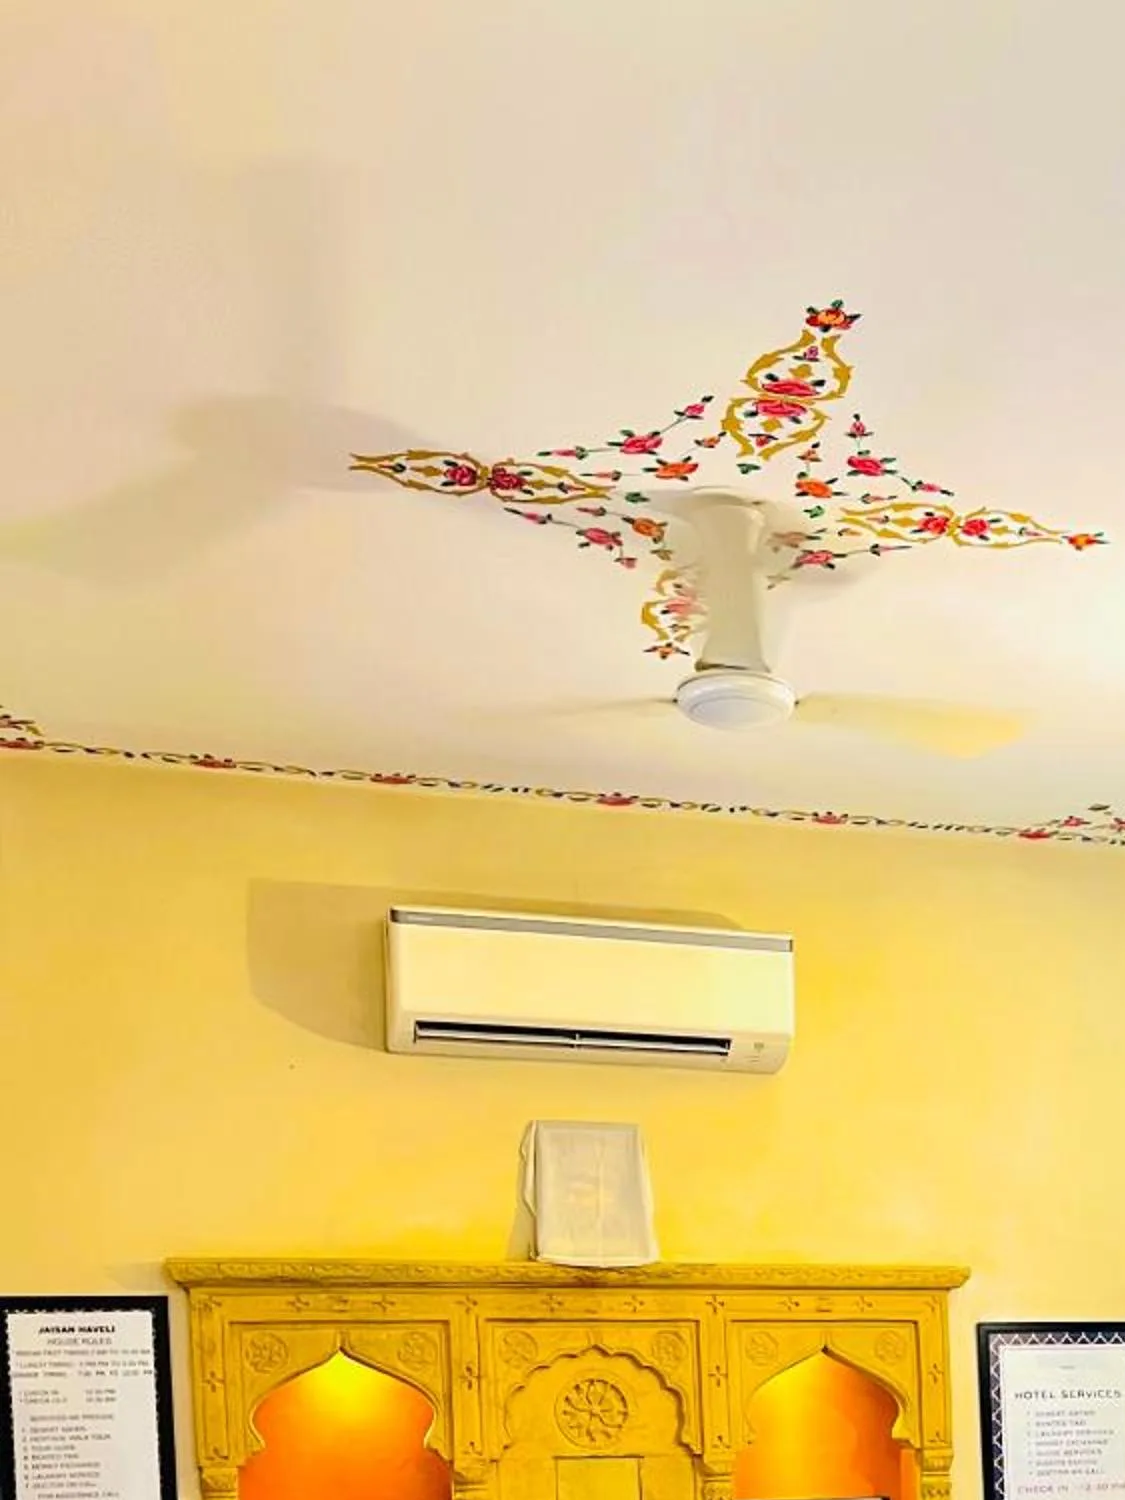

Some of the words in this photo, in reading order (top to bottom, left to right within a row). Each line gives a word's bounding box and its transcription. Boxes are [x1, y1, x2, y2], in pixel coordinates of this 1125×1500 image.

[78, 1325, 116, 1333] HAVELI
[1014, 1390, 1056, 1401] HOTEL
[1061, 1389, 1122, 1399] SERVICES
